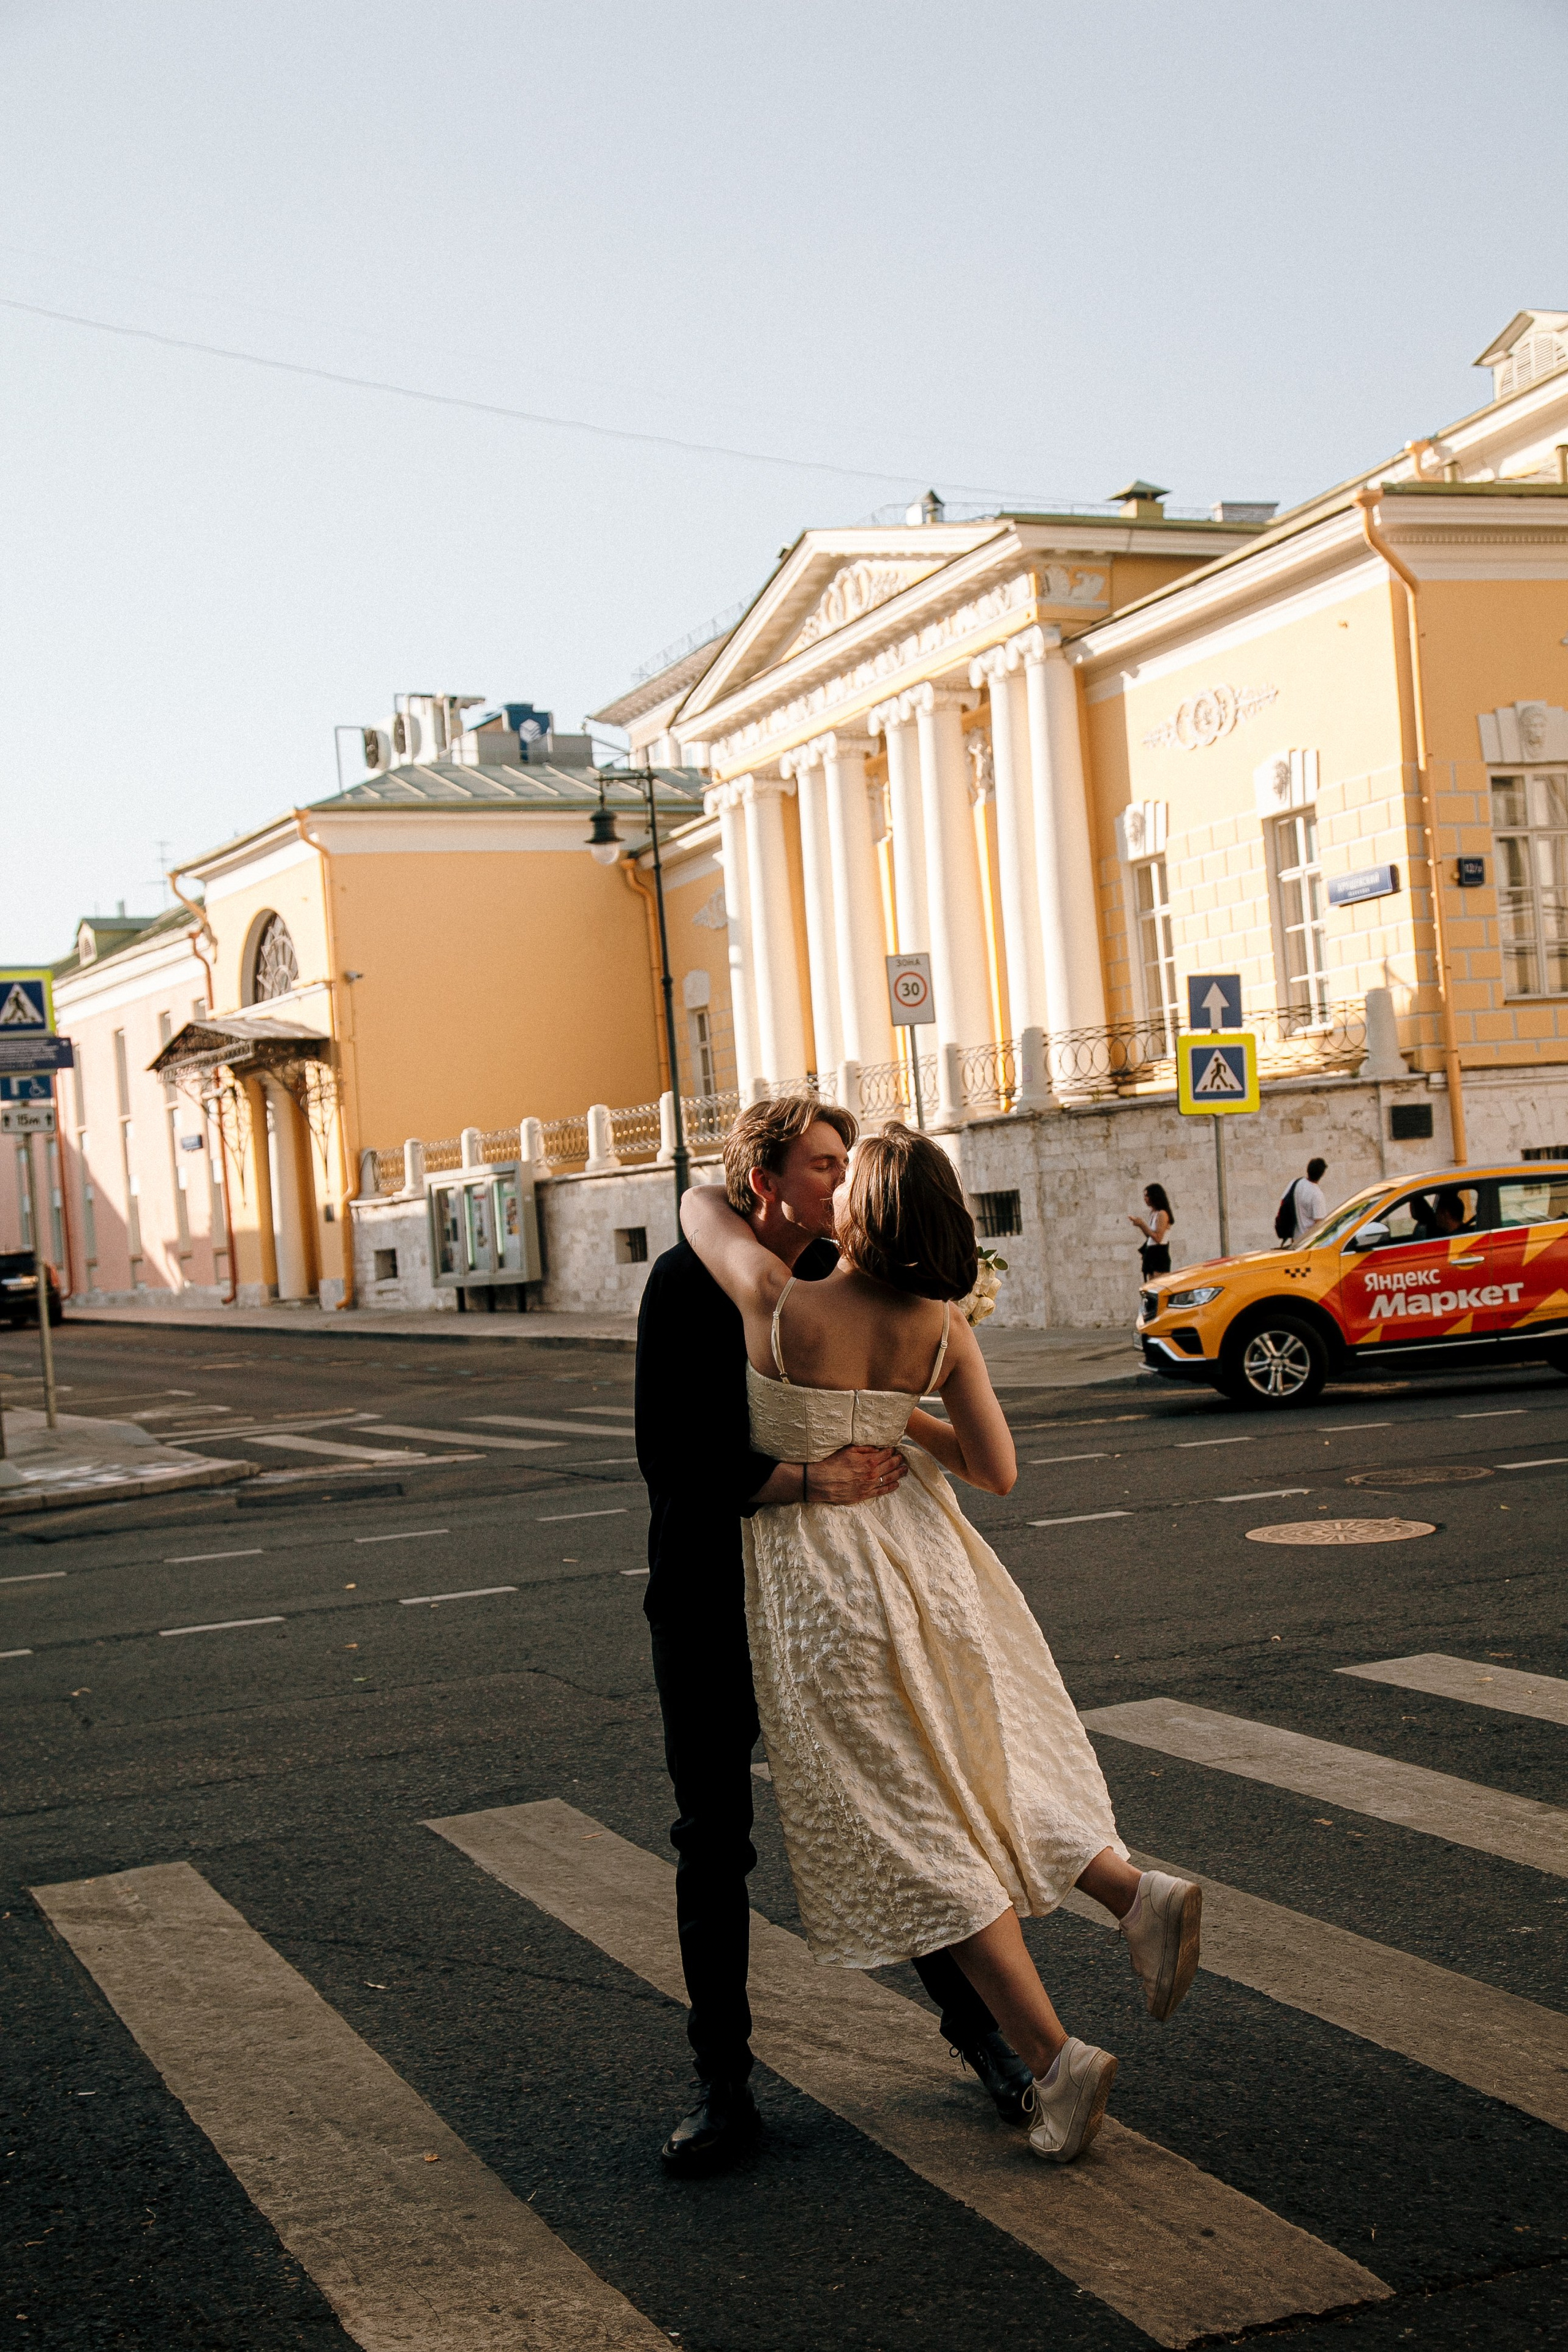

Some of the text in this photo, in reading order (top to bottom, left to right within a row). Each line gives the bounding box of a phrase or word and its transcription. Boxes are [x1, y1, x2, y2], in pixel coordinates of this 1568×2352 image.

[902, 982, 919, 997] 30
[1364, 1268, 1441, 1292] Яндекс
[1368, 1282, 1524, 1319] Маркет
